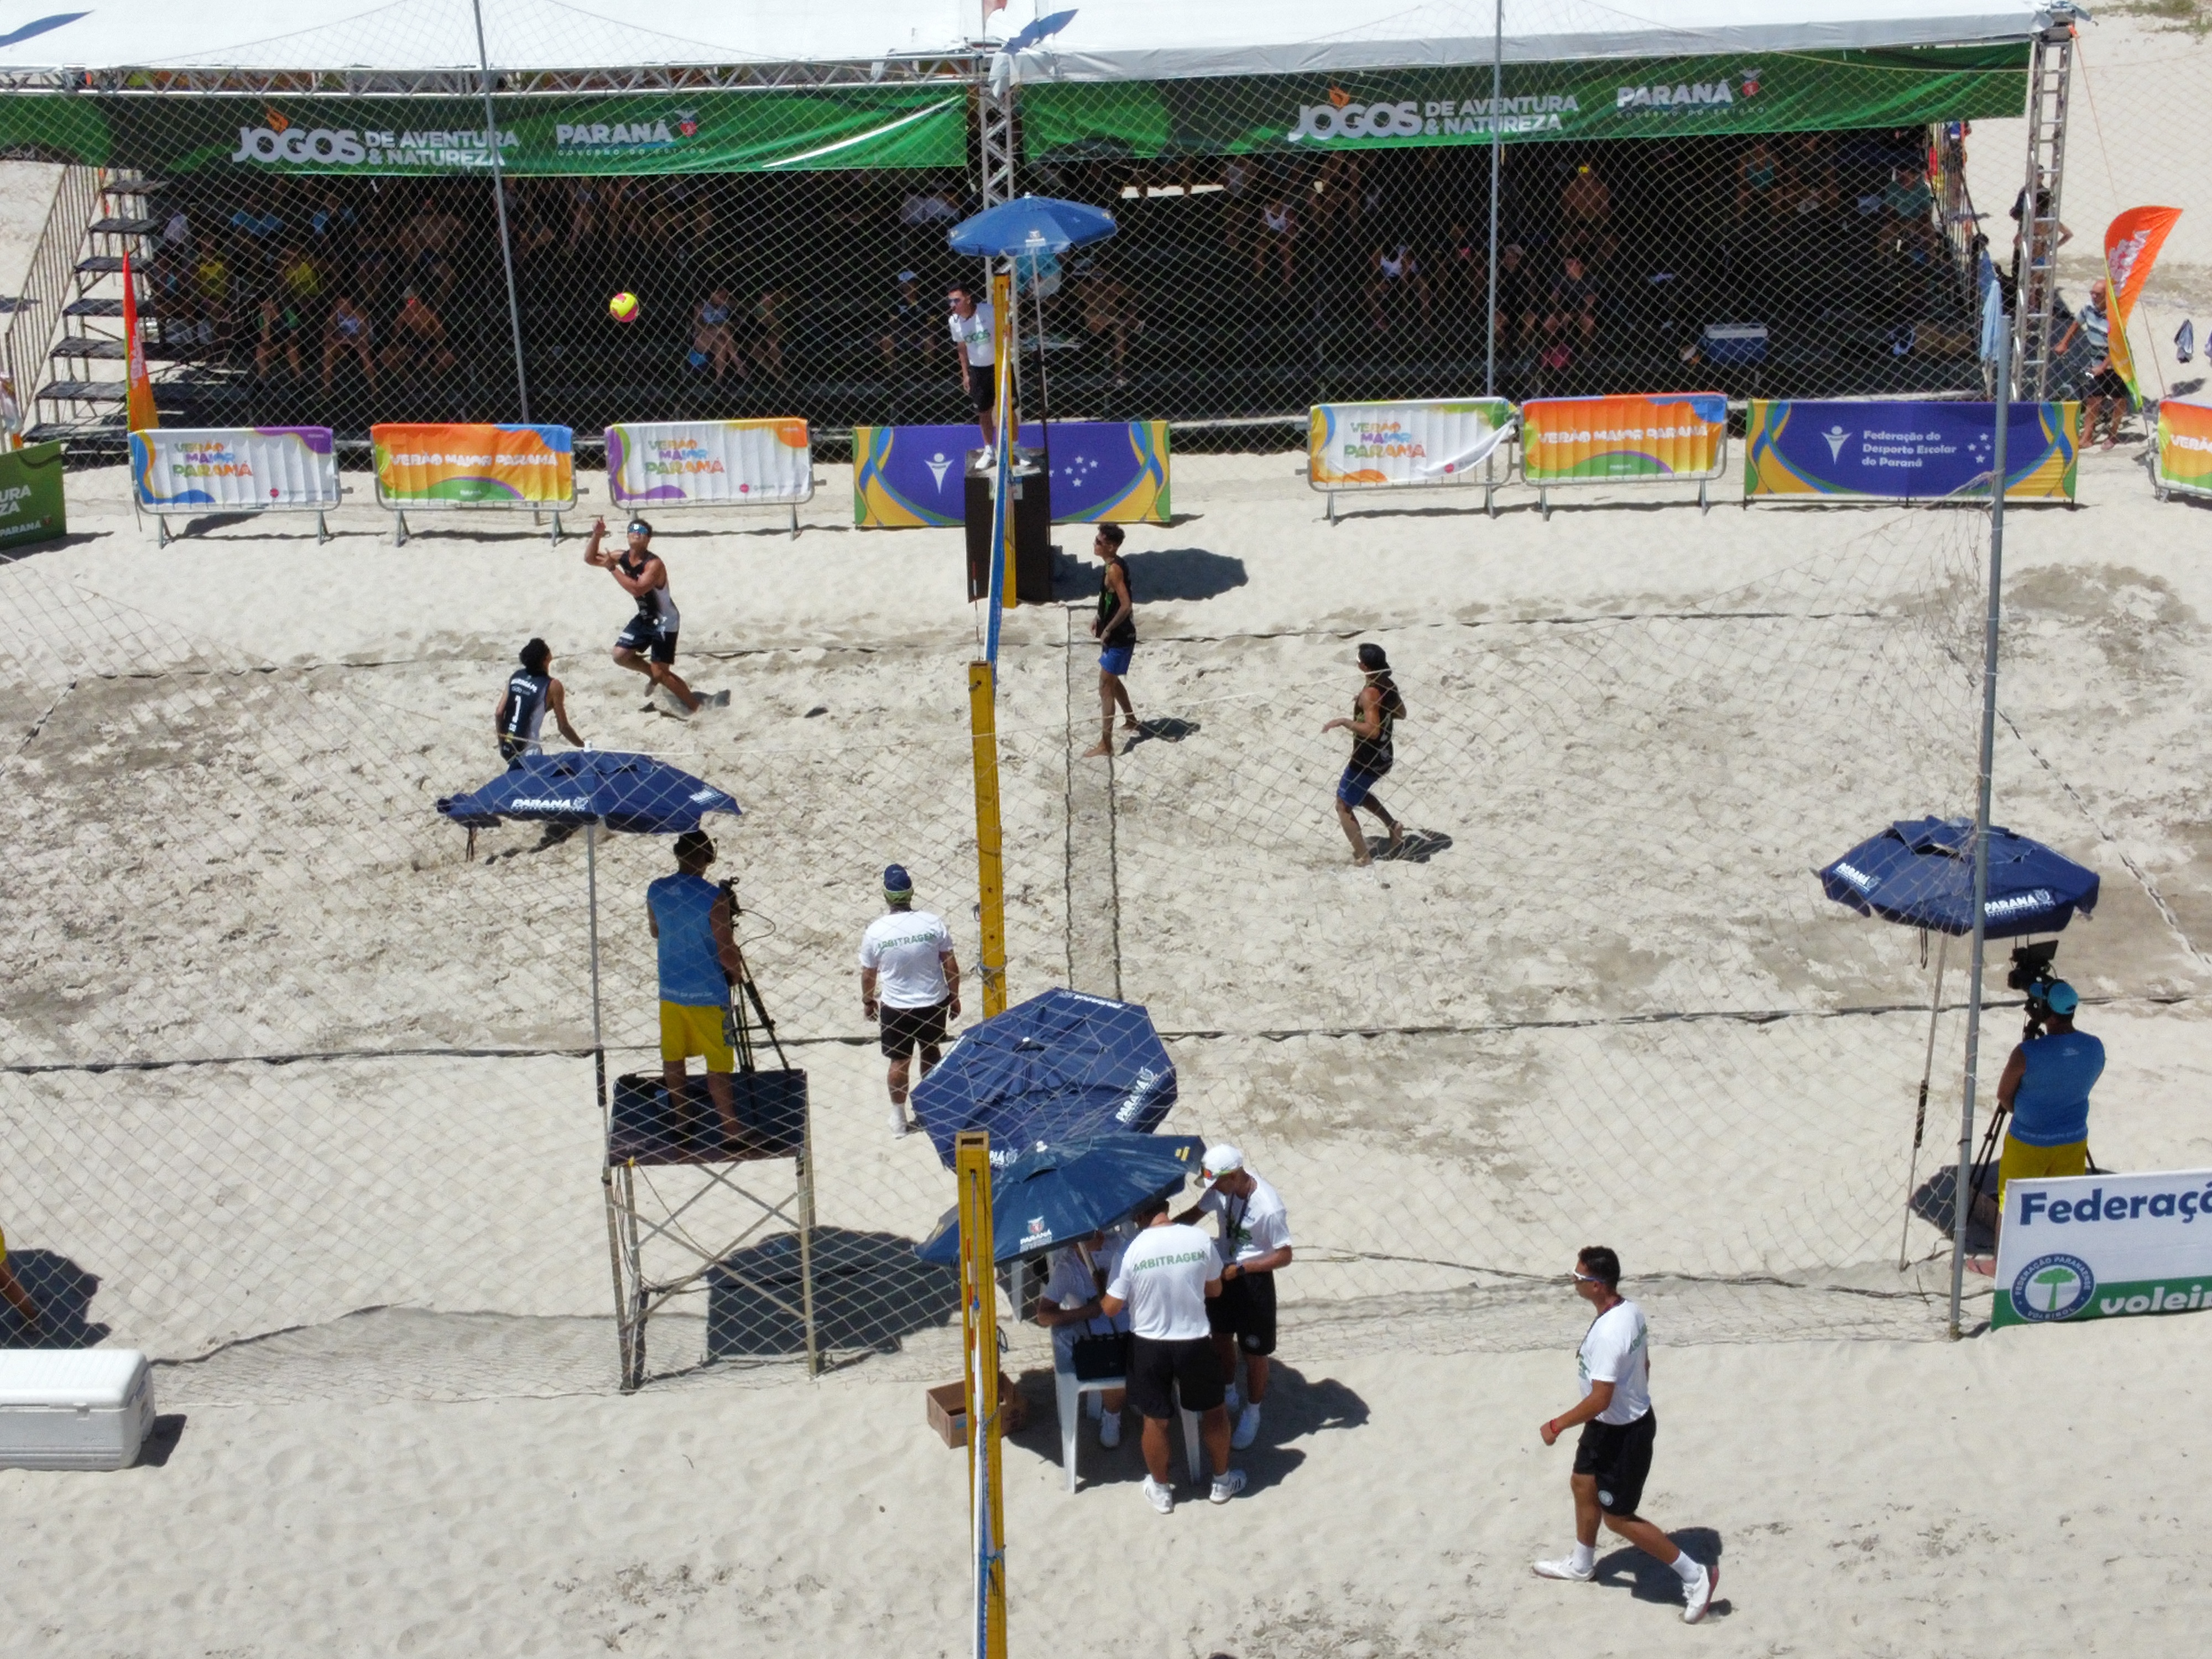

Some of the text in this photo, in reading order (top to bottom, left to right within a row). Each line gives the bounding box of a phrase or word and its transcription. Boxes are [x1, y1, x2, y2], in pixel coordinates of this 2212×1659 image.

[1617, 79, 1733, 107] PARANÁ
[1425, 95, 1578, 117] DE AVENTURA
[556, 119, 674, 144] PARANÁ
[1287, 101, 1423, 142] JOGOS
[1425, 114, 1562, 135] & NATUREZA
[231, 127, 366, 164] JOGOS
[366, 131, 520, 148] DE AVENTURA
[368, 150, 505, 166] & NATUREZA
[1864, 430, 1941, 443] Federação do
[1863, 444, 1957, 455] Desporto Escolar
[1861, 457, 1923, 467] do Paraná
[512, 695, 521, 723] 1
